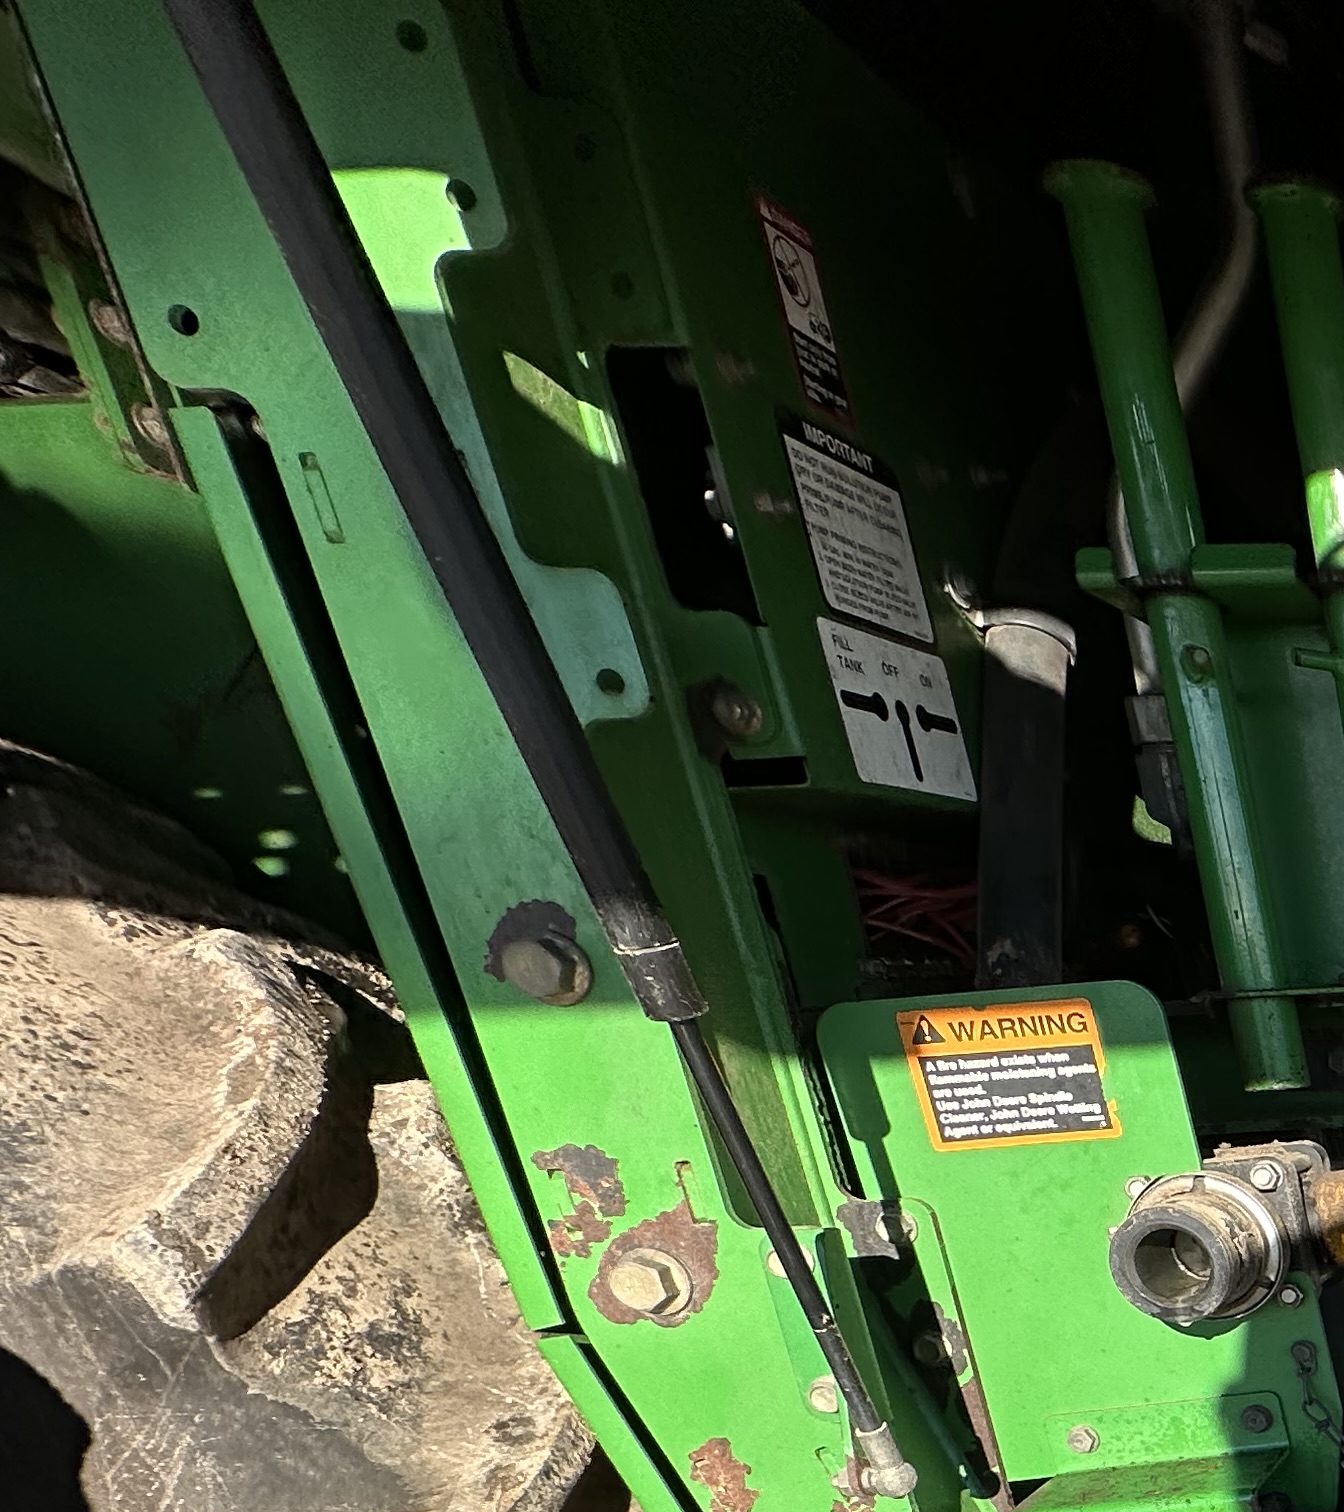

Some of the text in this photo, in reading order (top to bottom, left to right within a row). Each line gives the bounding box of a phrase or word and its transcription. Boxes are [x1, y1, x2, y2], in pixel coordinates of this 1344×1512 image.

[802, 421, 874, 473] IMPORTANT
[831, 633, 855, 653] FILL
[836, 654, 934, 689] TANK OFF ON
[946, 1010, 1090, 1043] WARNING
[925, 1060, 937, 1073] A
[959, 1056, 999, 1070] hazard
[1037, 1051, 1070, 1065] when
[1057, 1062, 1097, 1078] agents
[932, 1084, 988, 1100] are used.
[935, 1089, 1074, 1113] Use John Deere Spindle
[990, 1107, 1020, 1121] John
[1020, 1105, 1056, 1119] Deere
[1056, 1101, 1102, 1116] Wetting
[943, 1118, 1060, 1139] Agent or equivalent.
